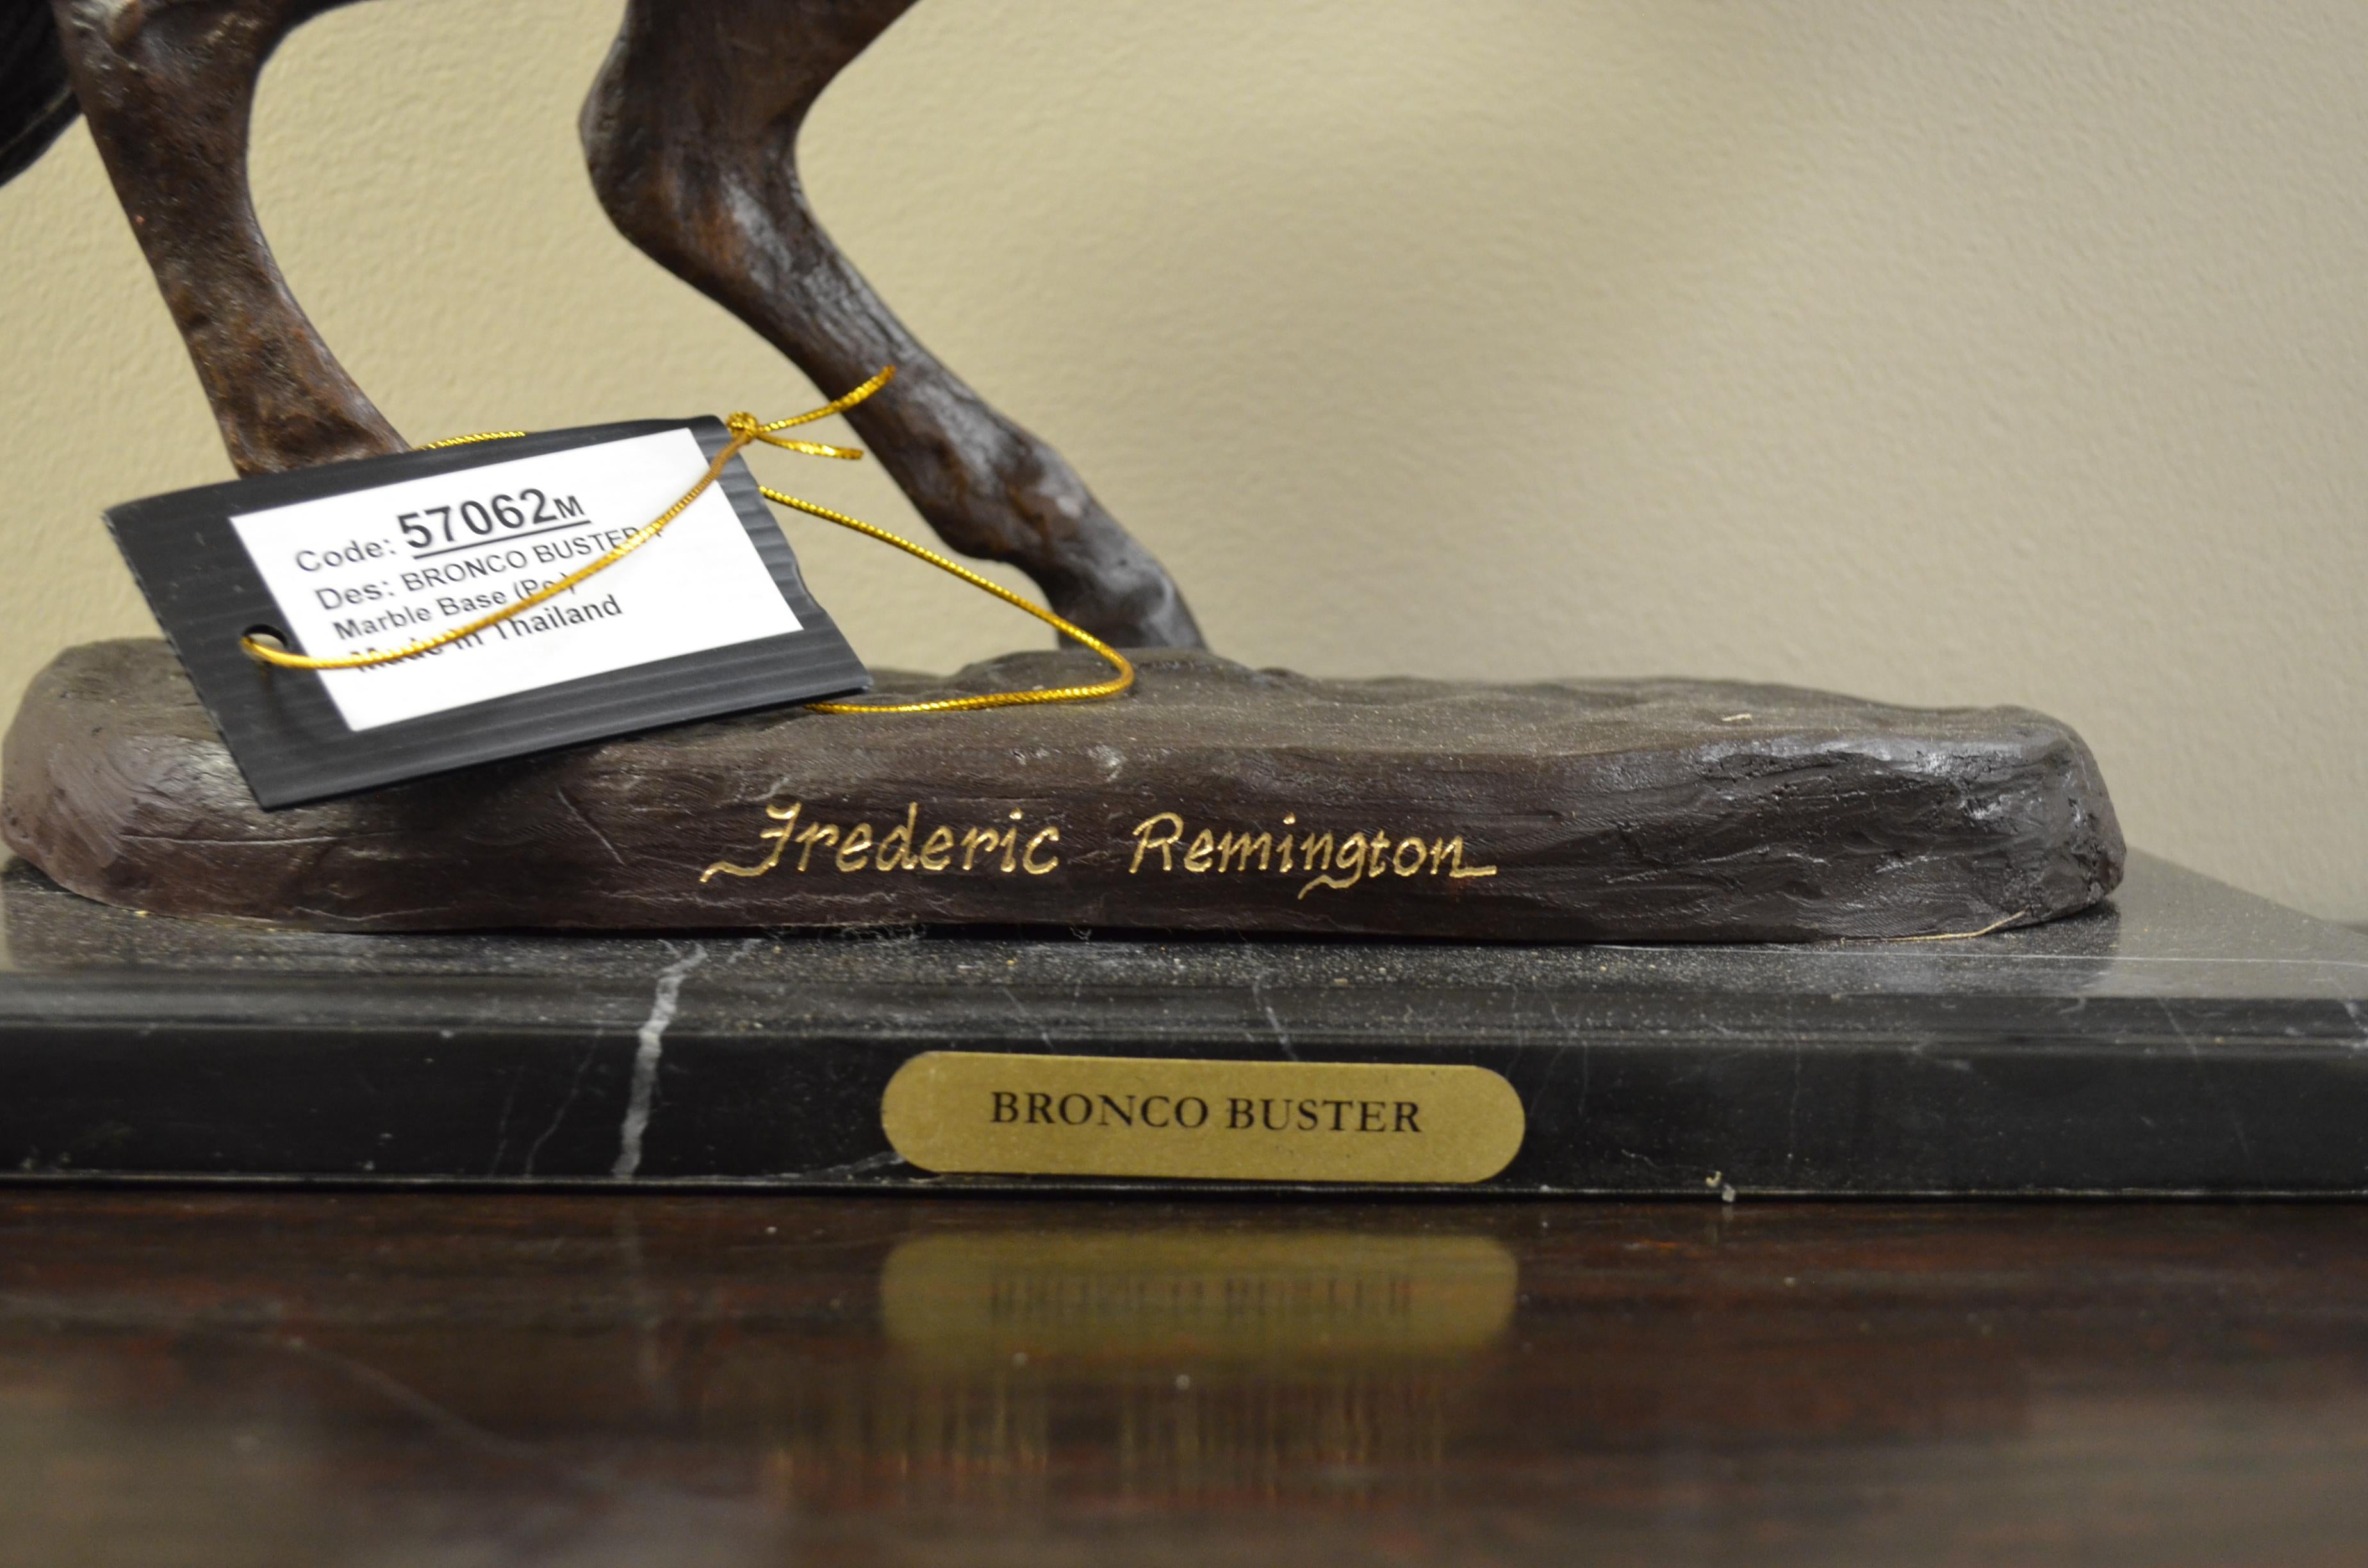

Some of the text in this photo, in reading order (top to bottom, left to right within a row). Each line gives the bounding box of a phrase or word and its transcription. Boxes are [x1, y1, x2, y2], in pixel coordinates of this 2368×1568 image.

[295, 487, 586, 573] Code: 57062M
[315, 579, 396, 610] Des:
[401, 549, 527, 592] BRONCO
[332, 605, 432, 641] Marble
[437, 587, 507, 616] Base
[700, 801, 1497, 900] Frederic Remington
[991, 1091, 1421, 1133] BRONCO BUSTER
